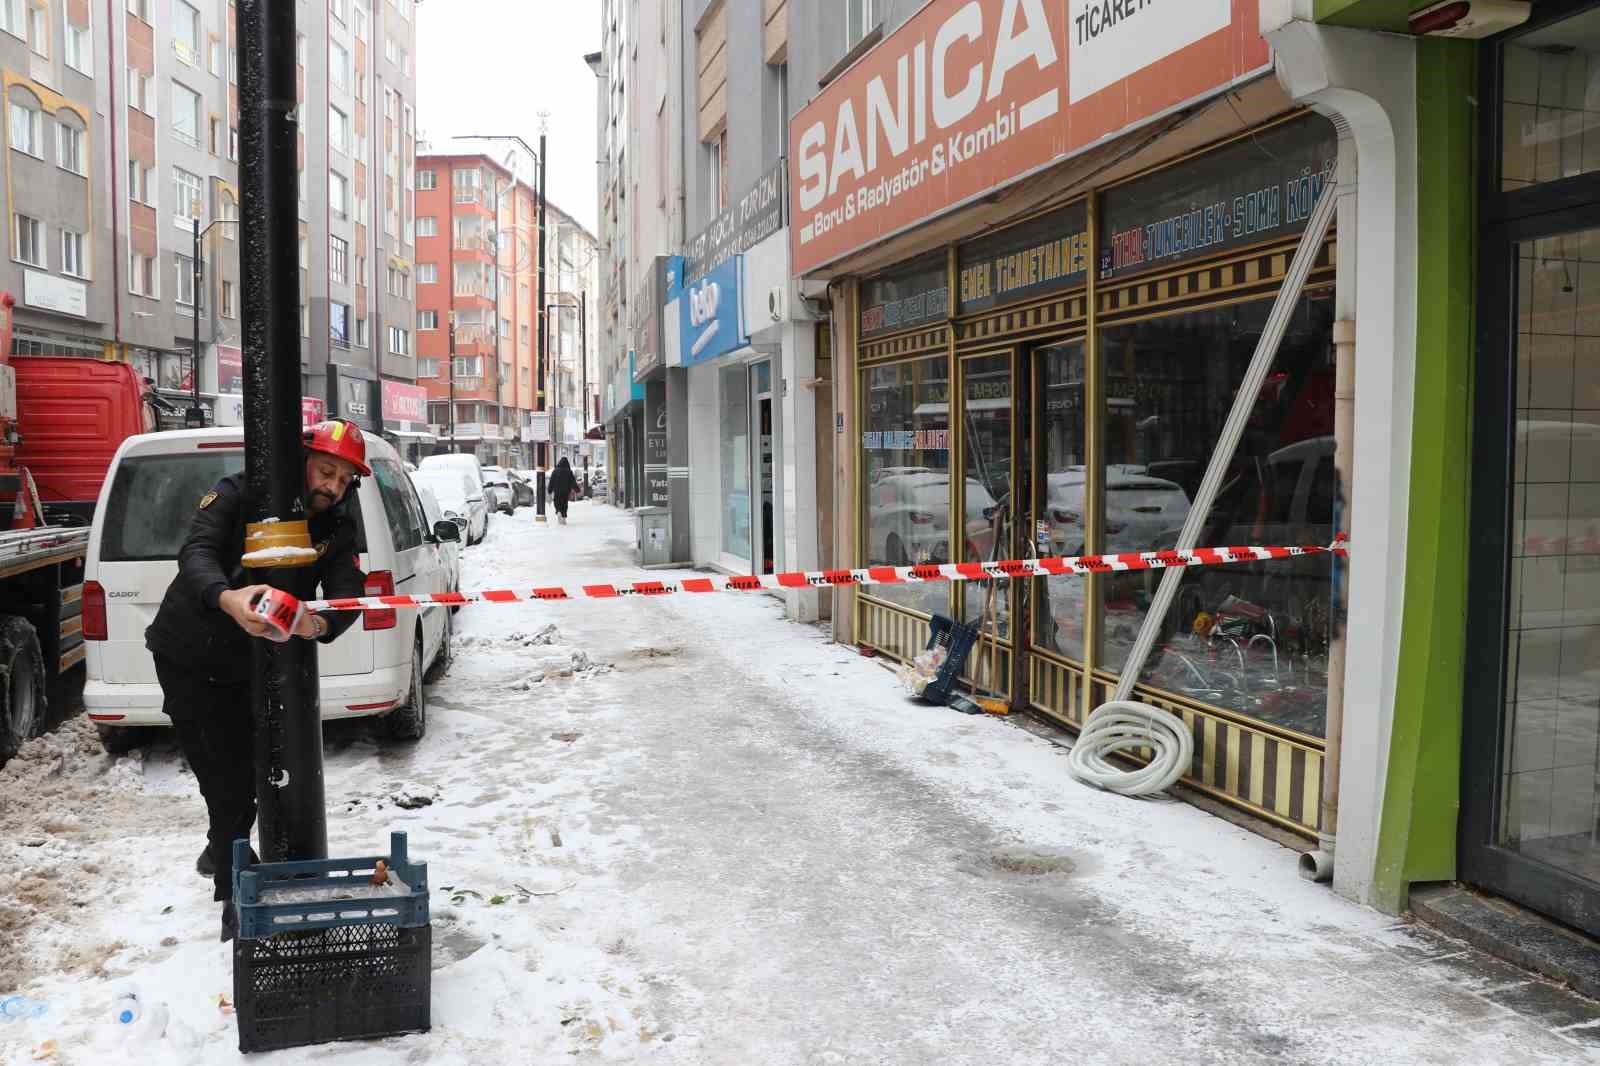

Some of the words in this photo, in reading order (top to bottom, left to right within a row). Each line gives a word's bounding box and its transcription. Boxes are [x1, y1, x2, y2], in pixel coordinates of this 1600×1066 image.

[799, 0, 1057, 210] SANICA
[813, 206, 844, 237] Boru
[856, 158, 930, 215] Radyatör
[946, 101, 1017, 166] Kombi
